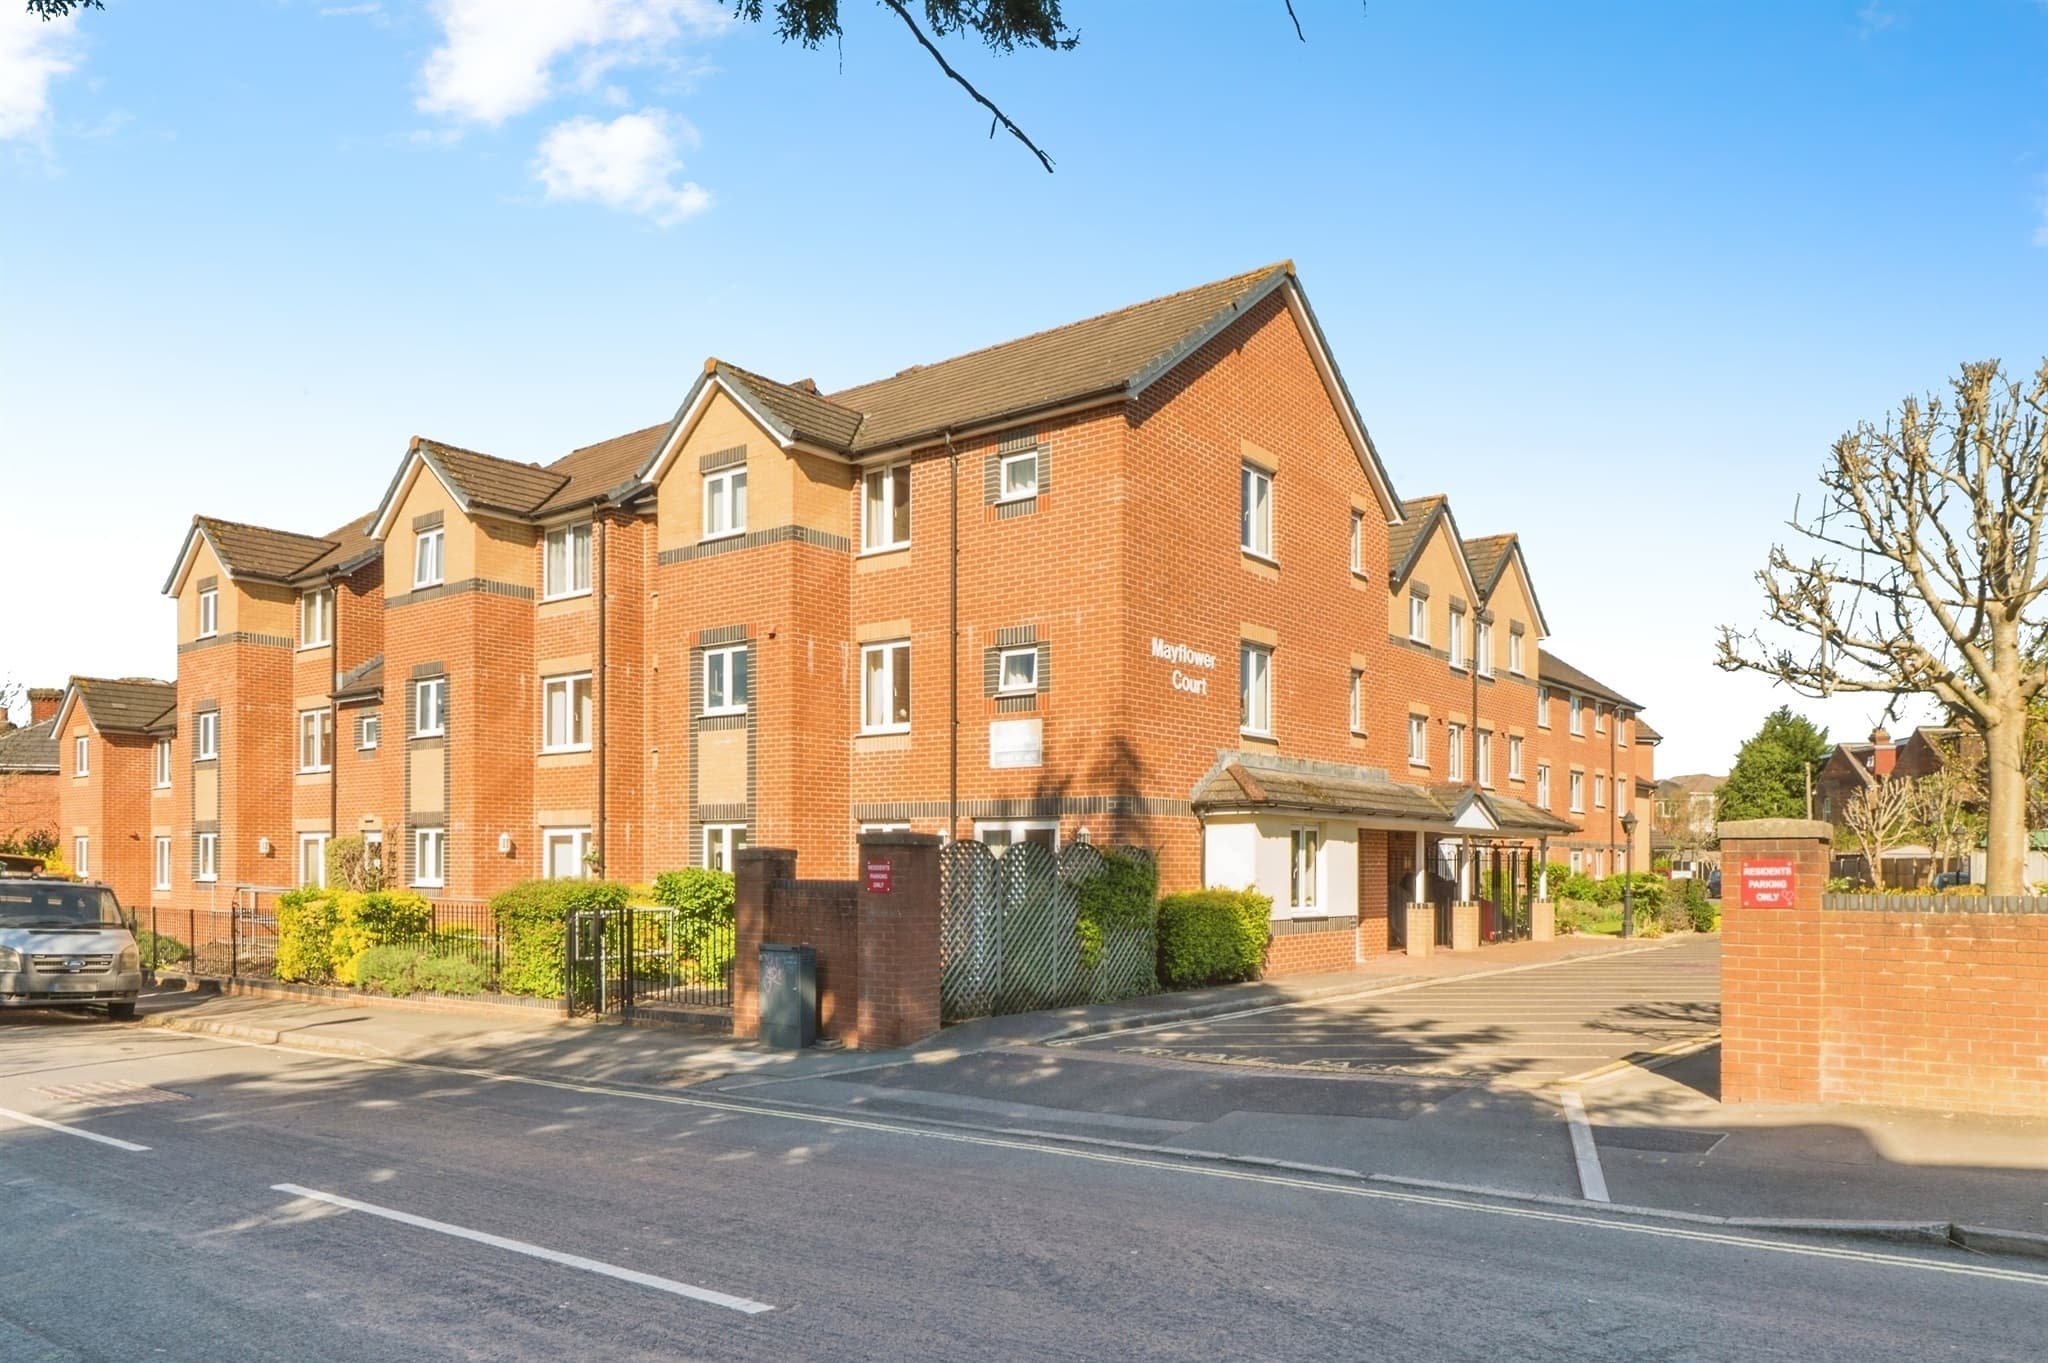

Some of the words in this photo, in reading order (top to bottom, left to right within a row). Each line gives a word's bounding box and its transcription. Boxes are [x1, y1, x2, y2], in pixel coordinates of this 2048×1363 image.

[1151, 636, 1216, 669] Mayflower
[1172, 669, 1207, 695] Court
[1743, 867, 1792, 876] RESIDENTS
[1748, 880, 1787, 889] PARKING
[1756, 893, 1779, 902] ONLY
